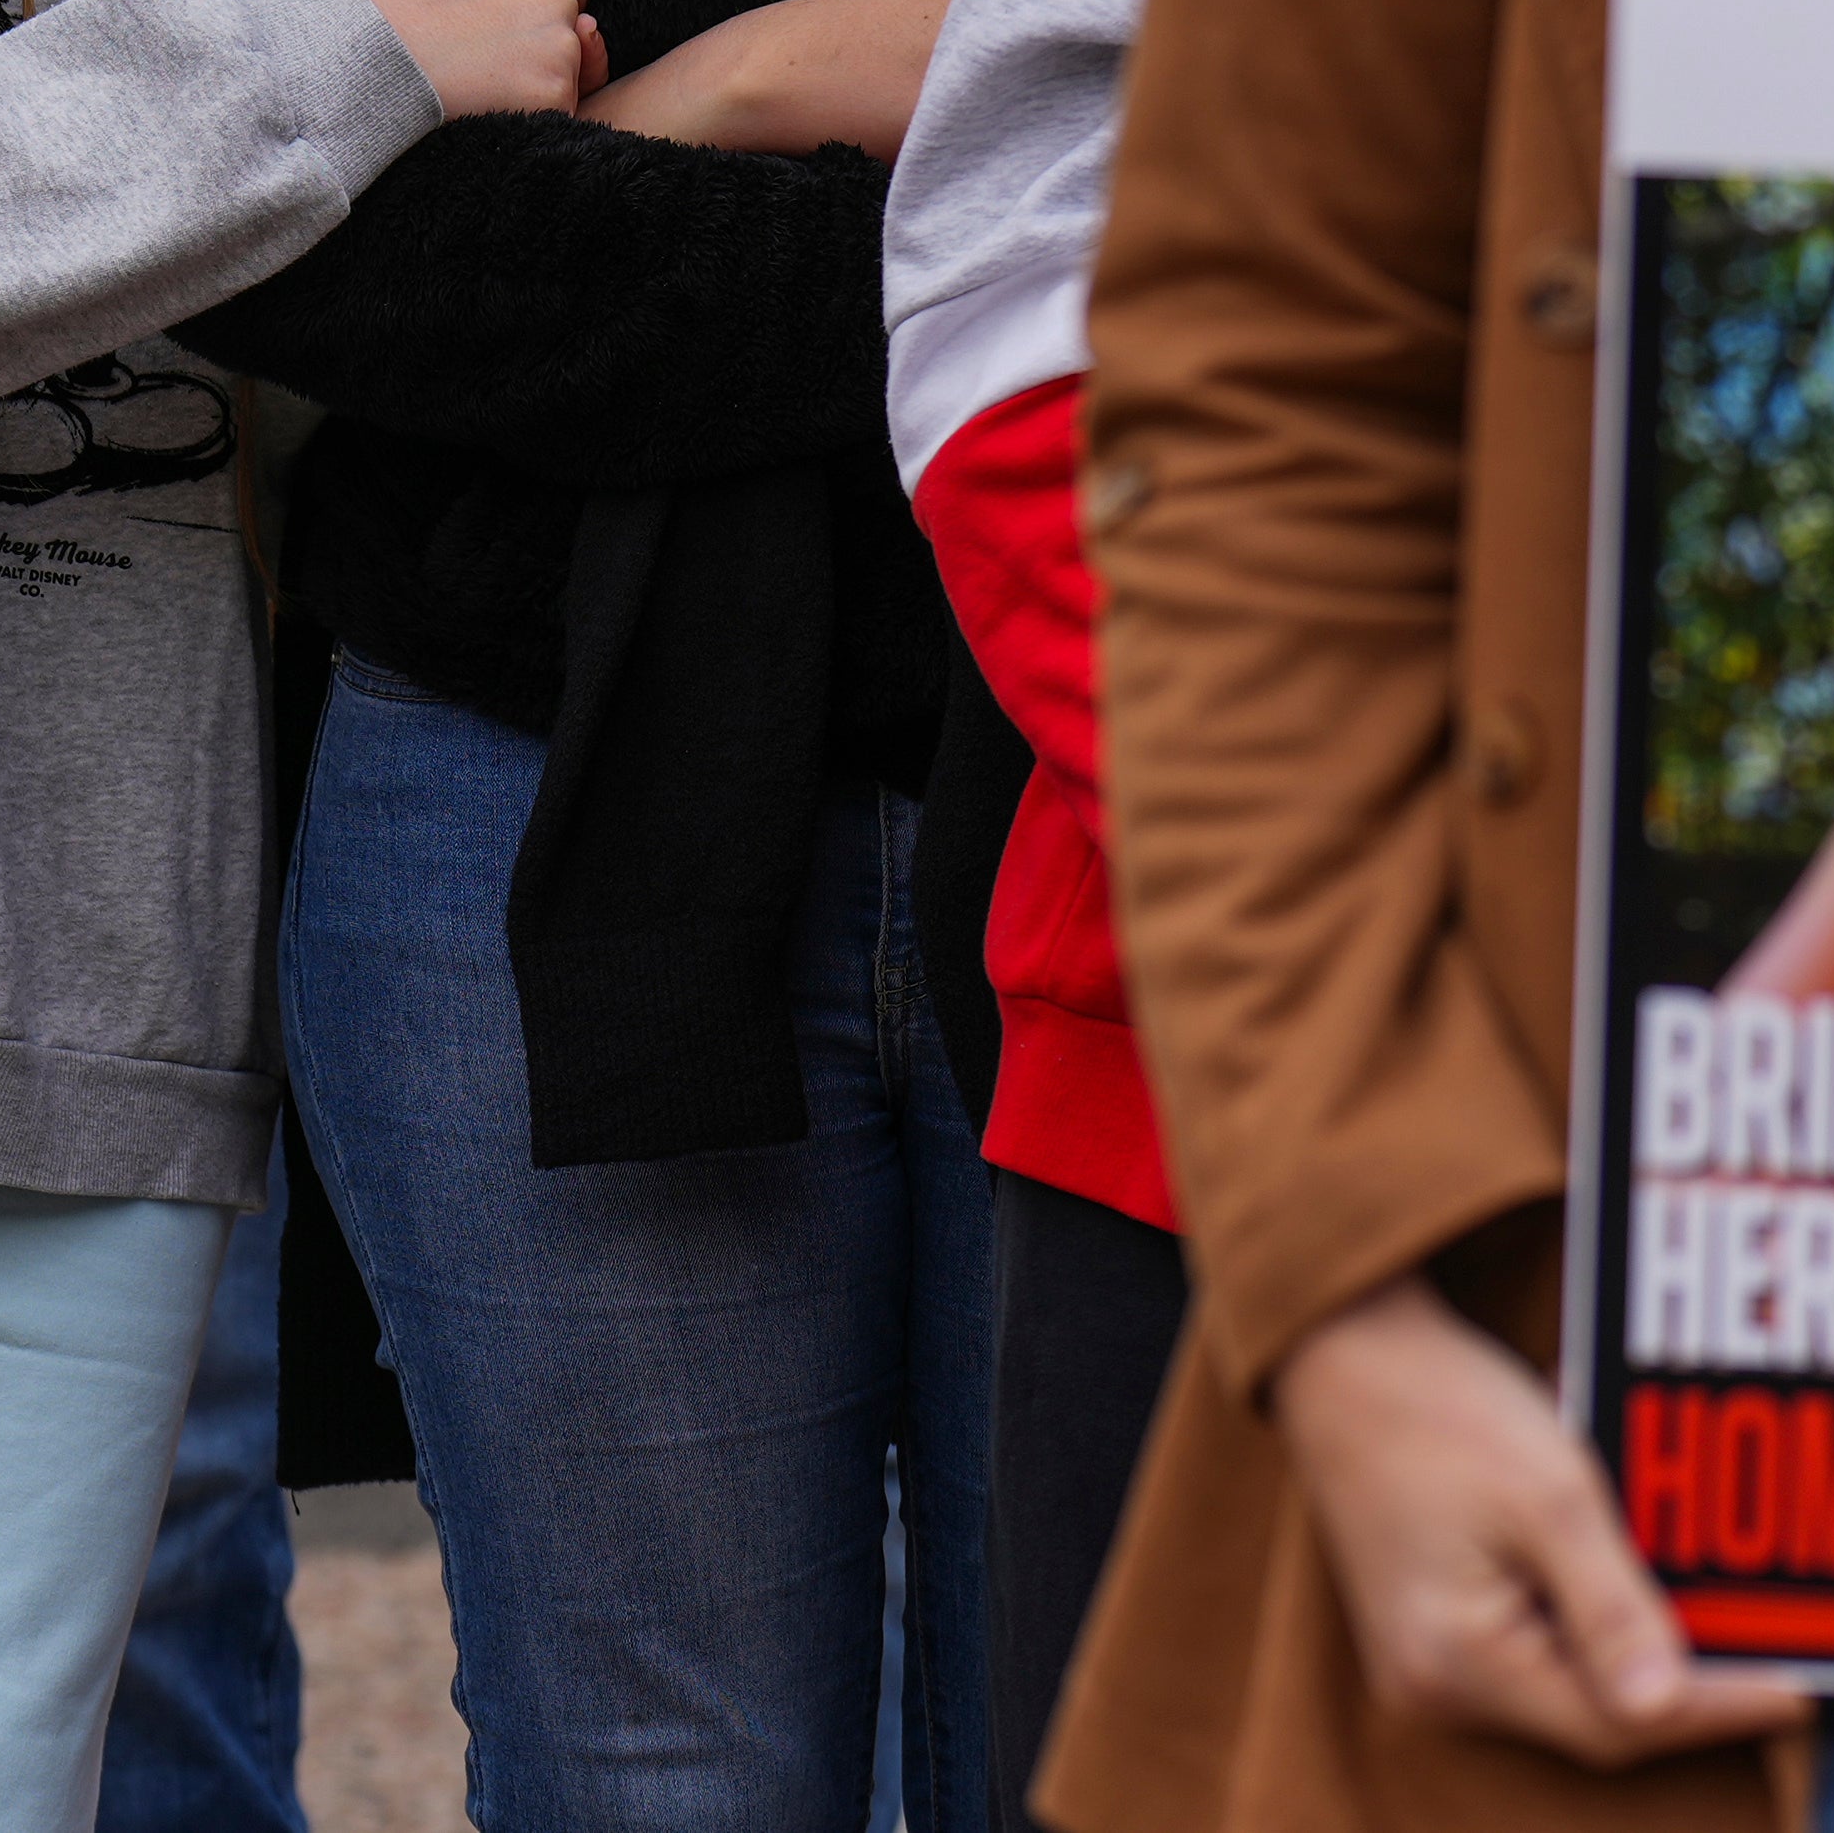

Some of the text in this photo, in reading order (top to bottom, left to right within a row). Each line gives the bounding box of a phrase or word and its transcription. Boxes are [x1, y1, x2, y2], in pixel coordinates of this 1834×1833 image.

[44, 539, 133, 569] Mouse
[29, 569, 82, 586] DISNEY
[19, 583, 45, 598] CO.
